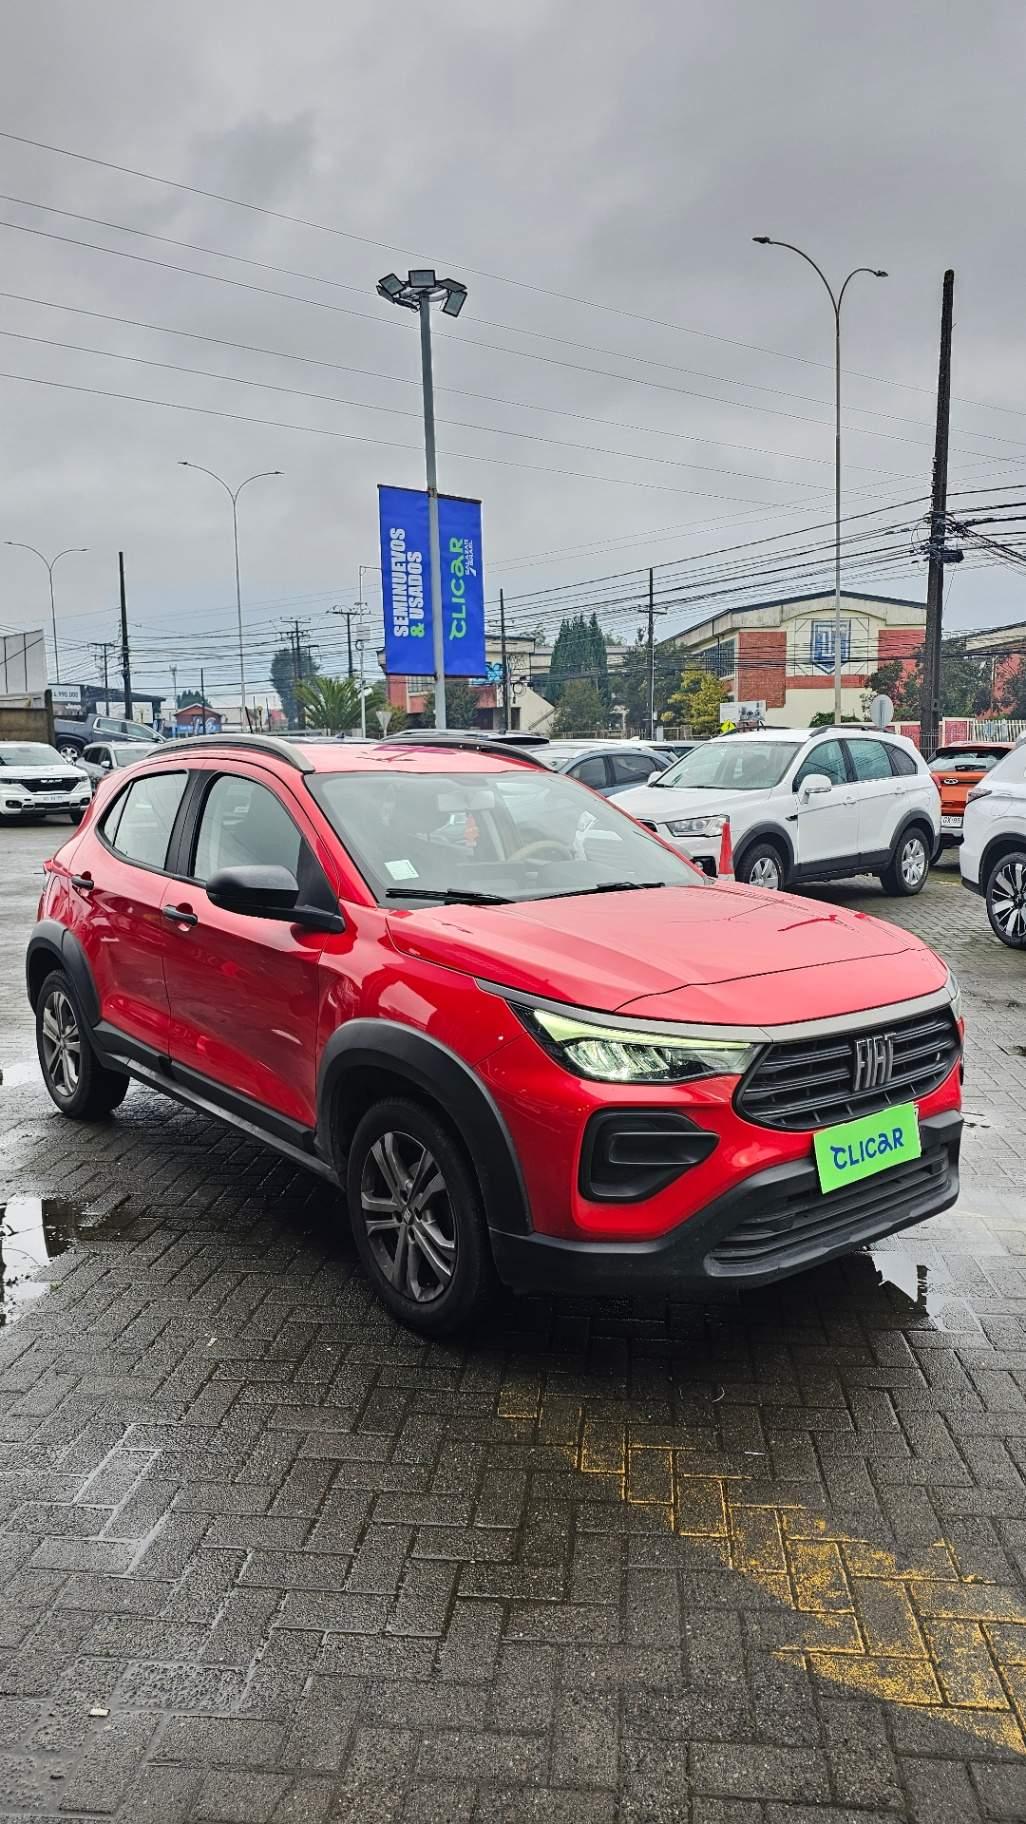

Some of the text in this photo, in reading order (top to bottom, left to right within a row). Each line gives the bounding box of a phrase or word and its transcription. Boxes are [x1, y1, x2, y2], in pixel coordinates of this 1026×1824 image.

[390, 528, 409, 637] SEMINUEVOS
[407, 551, 425, 638] & USADOS
